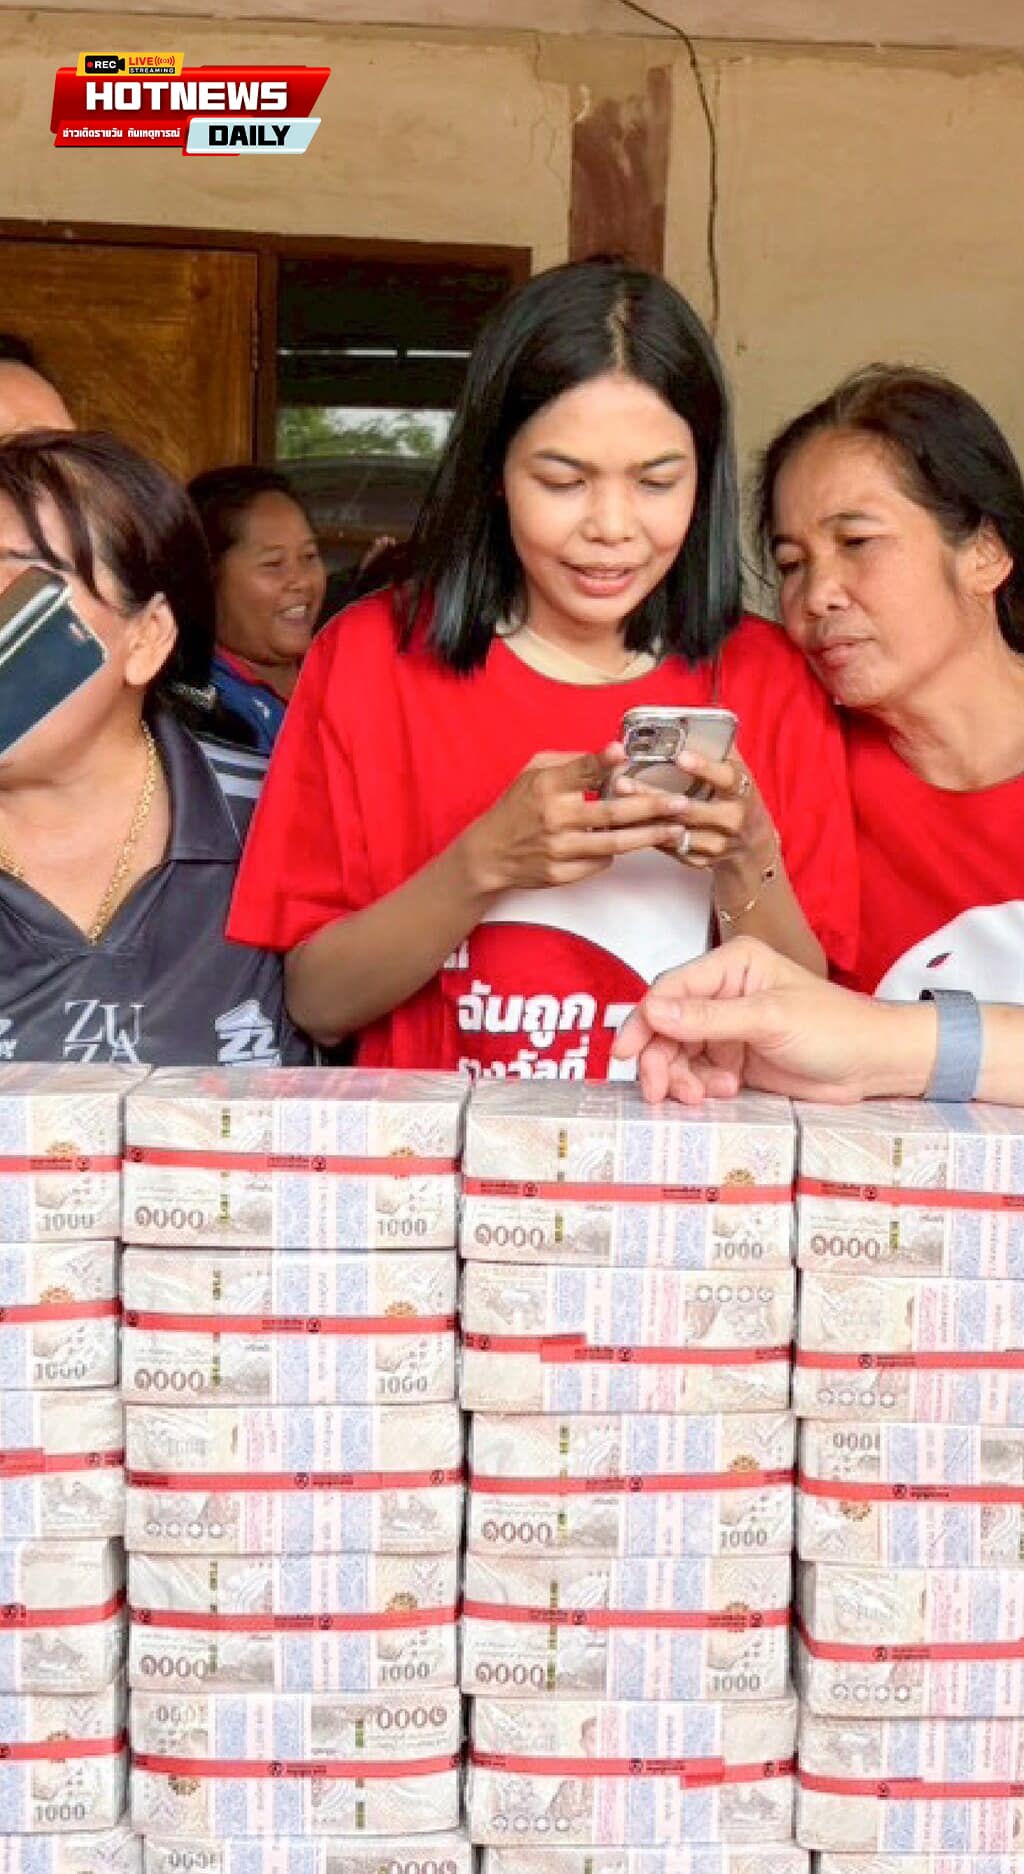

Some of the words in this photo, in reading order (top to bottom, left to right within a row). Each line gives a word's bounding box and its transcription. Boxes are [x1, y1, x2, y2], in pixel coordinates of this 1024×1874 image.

[457, 979, 598, 1048] ฉันถูก
[376, 1218, 428, 1237] 1000
[713, 1241, 763, 1260] 1000
[376, 1375, 428, 1395] 1000
[720, 1528, 768, 1548] 1000
[381, 1662, 431, 1682] 1000
[711, 1672, 761, 1691] 1000
[34, 1803, 86, 1823] 1000
